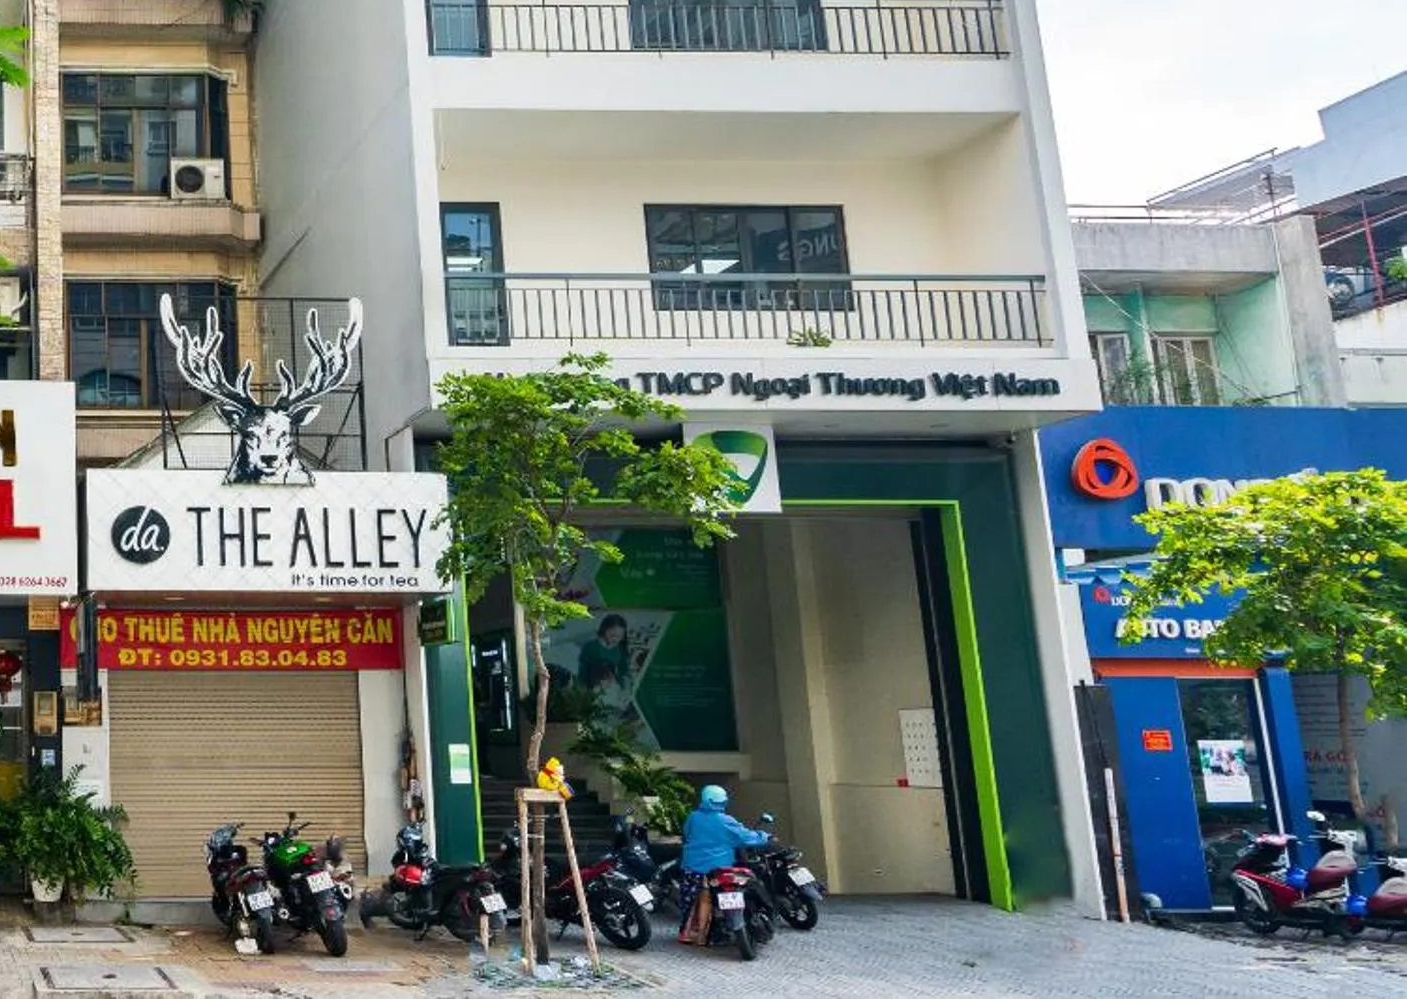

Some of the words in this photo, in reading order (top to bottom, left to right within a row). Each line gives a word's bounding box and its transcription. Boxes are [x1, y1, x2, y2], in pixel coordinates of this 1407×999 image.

[636, 371, 724, 396] TMCP
[731, 372, 811, 400] Ngoại
[931, 372, 989, 400] Việt
[994, 373, 1061, 396] Nam
[186, 507, 274, 567] THE
[289, 507, 428, 569] ALLEY
[320, 574, 359, 587] time
[361, 574, 386, 587] for
[389, 574, 419, 587] tea
[124, 613, 184, 643] THUÊ
[347, 612, 393, 644] CĂN
[118, 649, 161, 666] ĐT:
[170, 649, 348, 667] 0931.83.04.83
